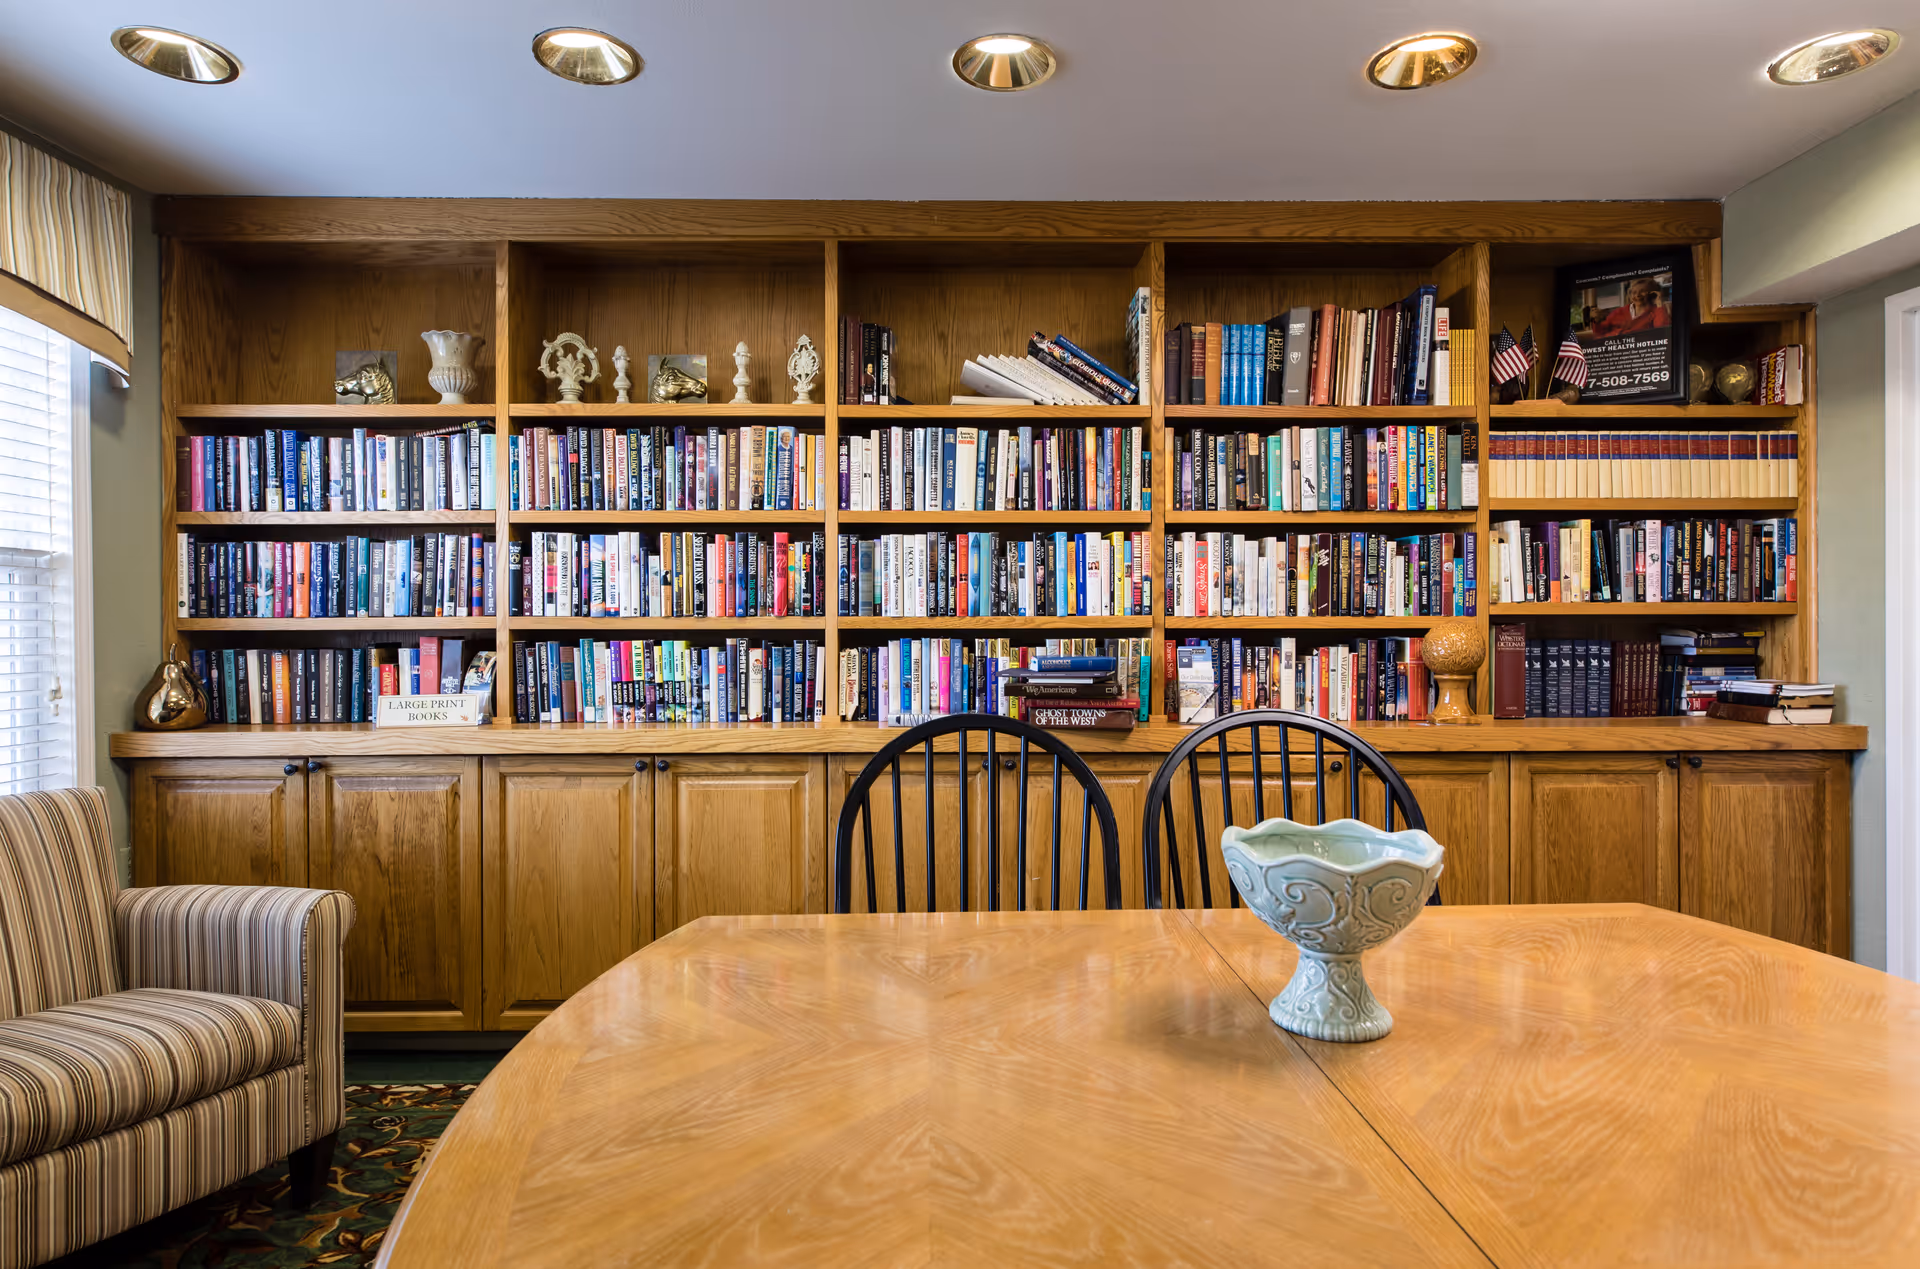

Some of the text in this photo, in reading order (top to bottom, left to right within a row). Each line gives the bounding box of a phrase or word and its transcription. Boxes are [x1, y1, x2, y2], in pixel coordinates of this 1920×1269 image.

[1438, 318, 1446, 336] LIFE
[1637, 339, 1668, 348] HOTLINE
[1273, 338, 1283, 372] BIBLE
[1044, 340, 1072, 361] AMERICA'S
[1072, 357, 1103, 380] GLORIOUS
[1103, 378, 1123, 394] QUILTS
[1588, 371, 1669, 388] 7-508-7569
[753, 428, 762, 458] DAN BROWN
[1344, 440, 1352, 464] DEAVER
[285, 432, 294, 480] DAVID BALDACCI
[851, 461, 861, 494] STORYVILLE
[426, 538, 435, 551] BODY
[695, 537, 704, 584] SECRET HOUSES
[1210, 640, 1218, 658] BRAD
[389, 700, 466, 710] LARGE PRINT
[1036, 709, 1107, 717] GHOST TOWNS
[408, 712, 448, 721] BOOKS
[1070, 717, 1097, 725] WEST
